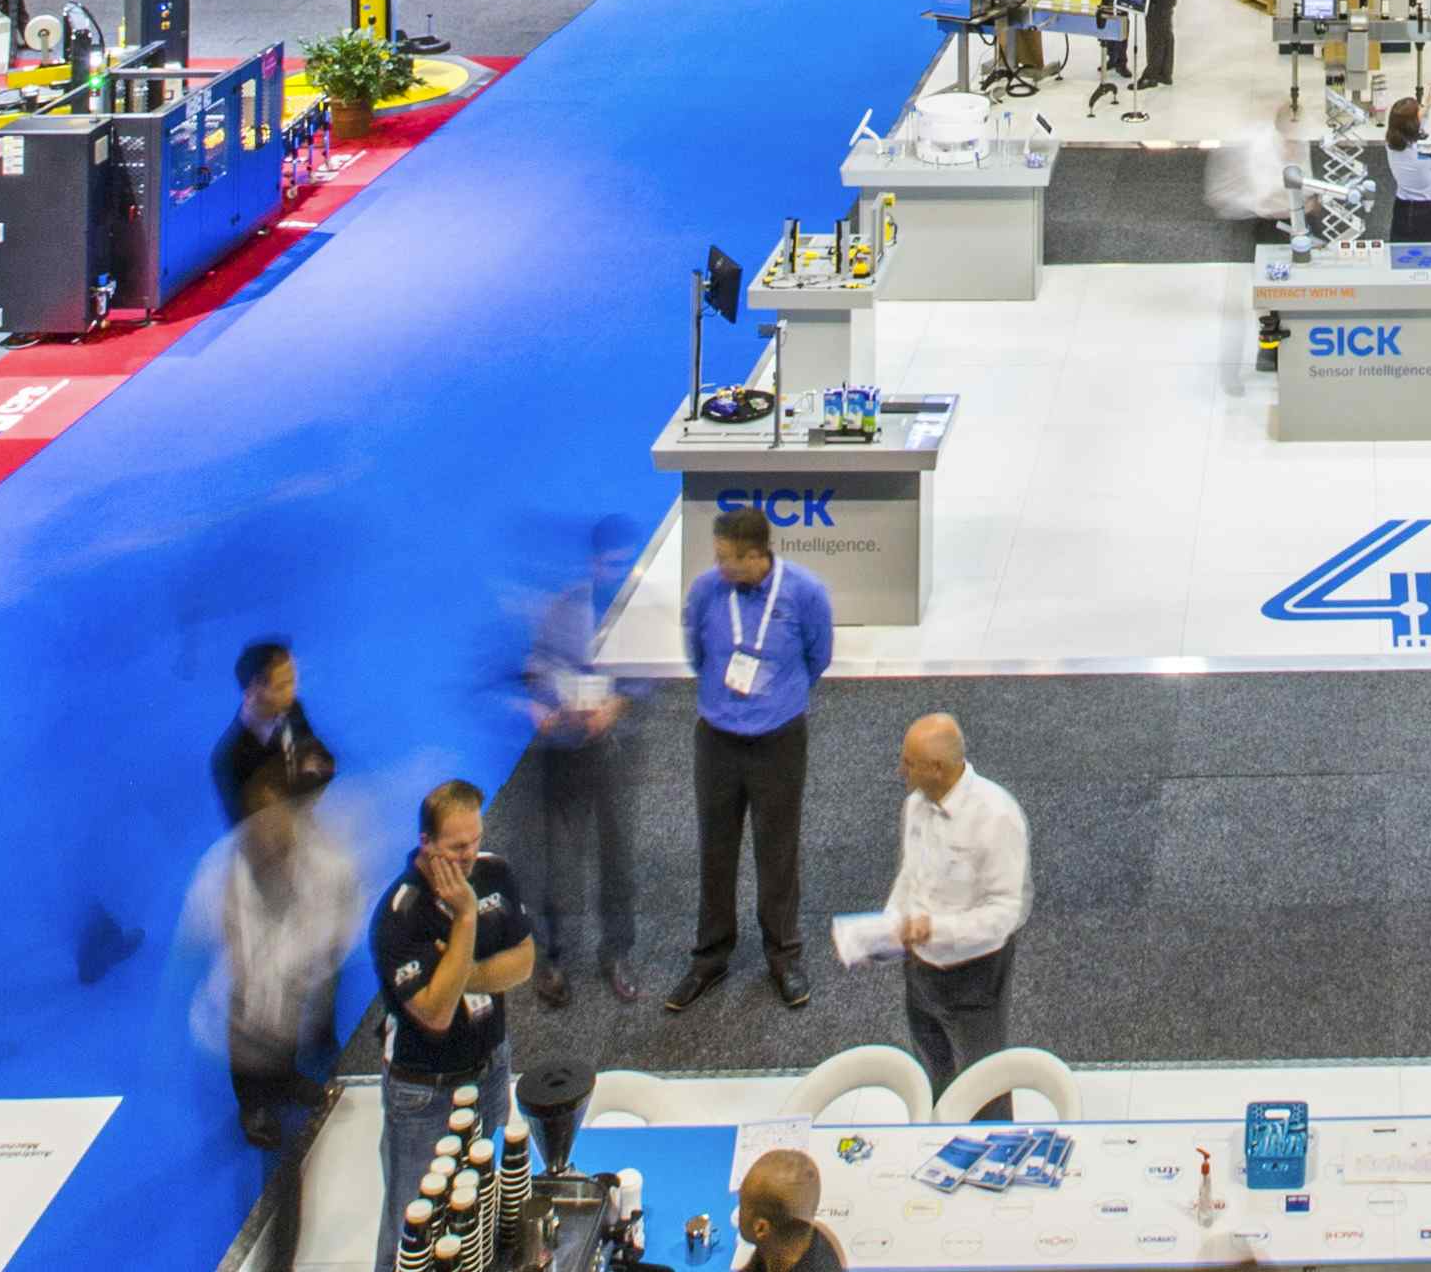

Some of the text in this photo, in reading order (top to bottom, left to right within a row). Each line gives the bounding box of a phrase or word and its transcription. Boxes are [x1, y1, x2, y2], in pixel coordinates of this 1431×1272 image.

[1255, 287, 1307, 300] INTERACT
[1310, 287, 1339, 299] WITH
[1308, 325, 1402, 357] SICK
[1309, 364, 1355, 378] Sensor
[780, 536, 882, 555] Intelligence.
